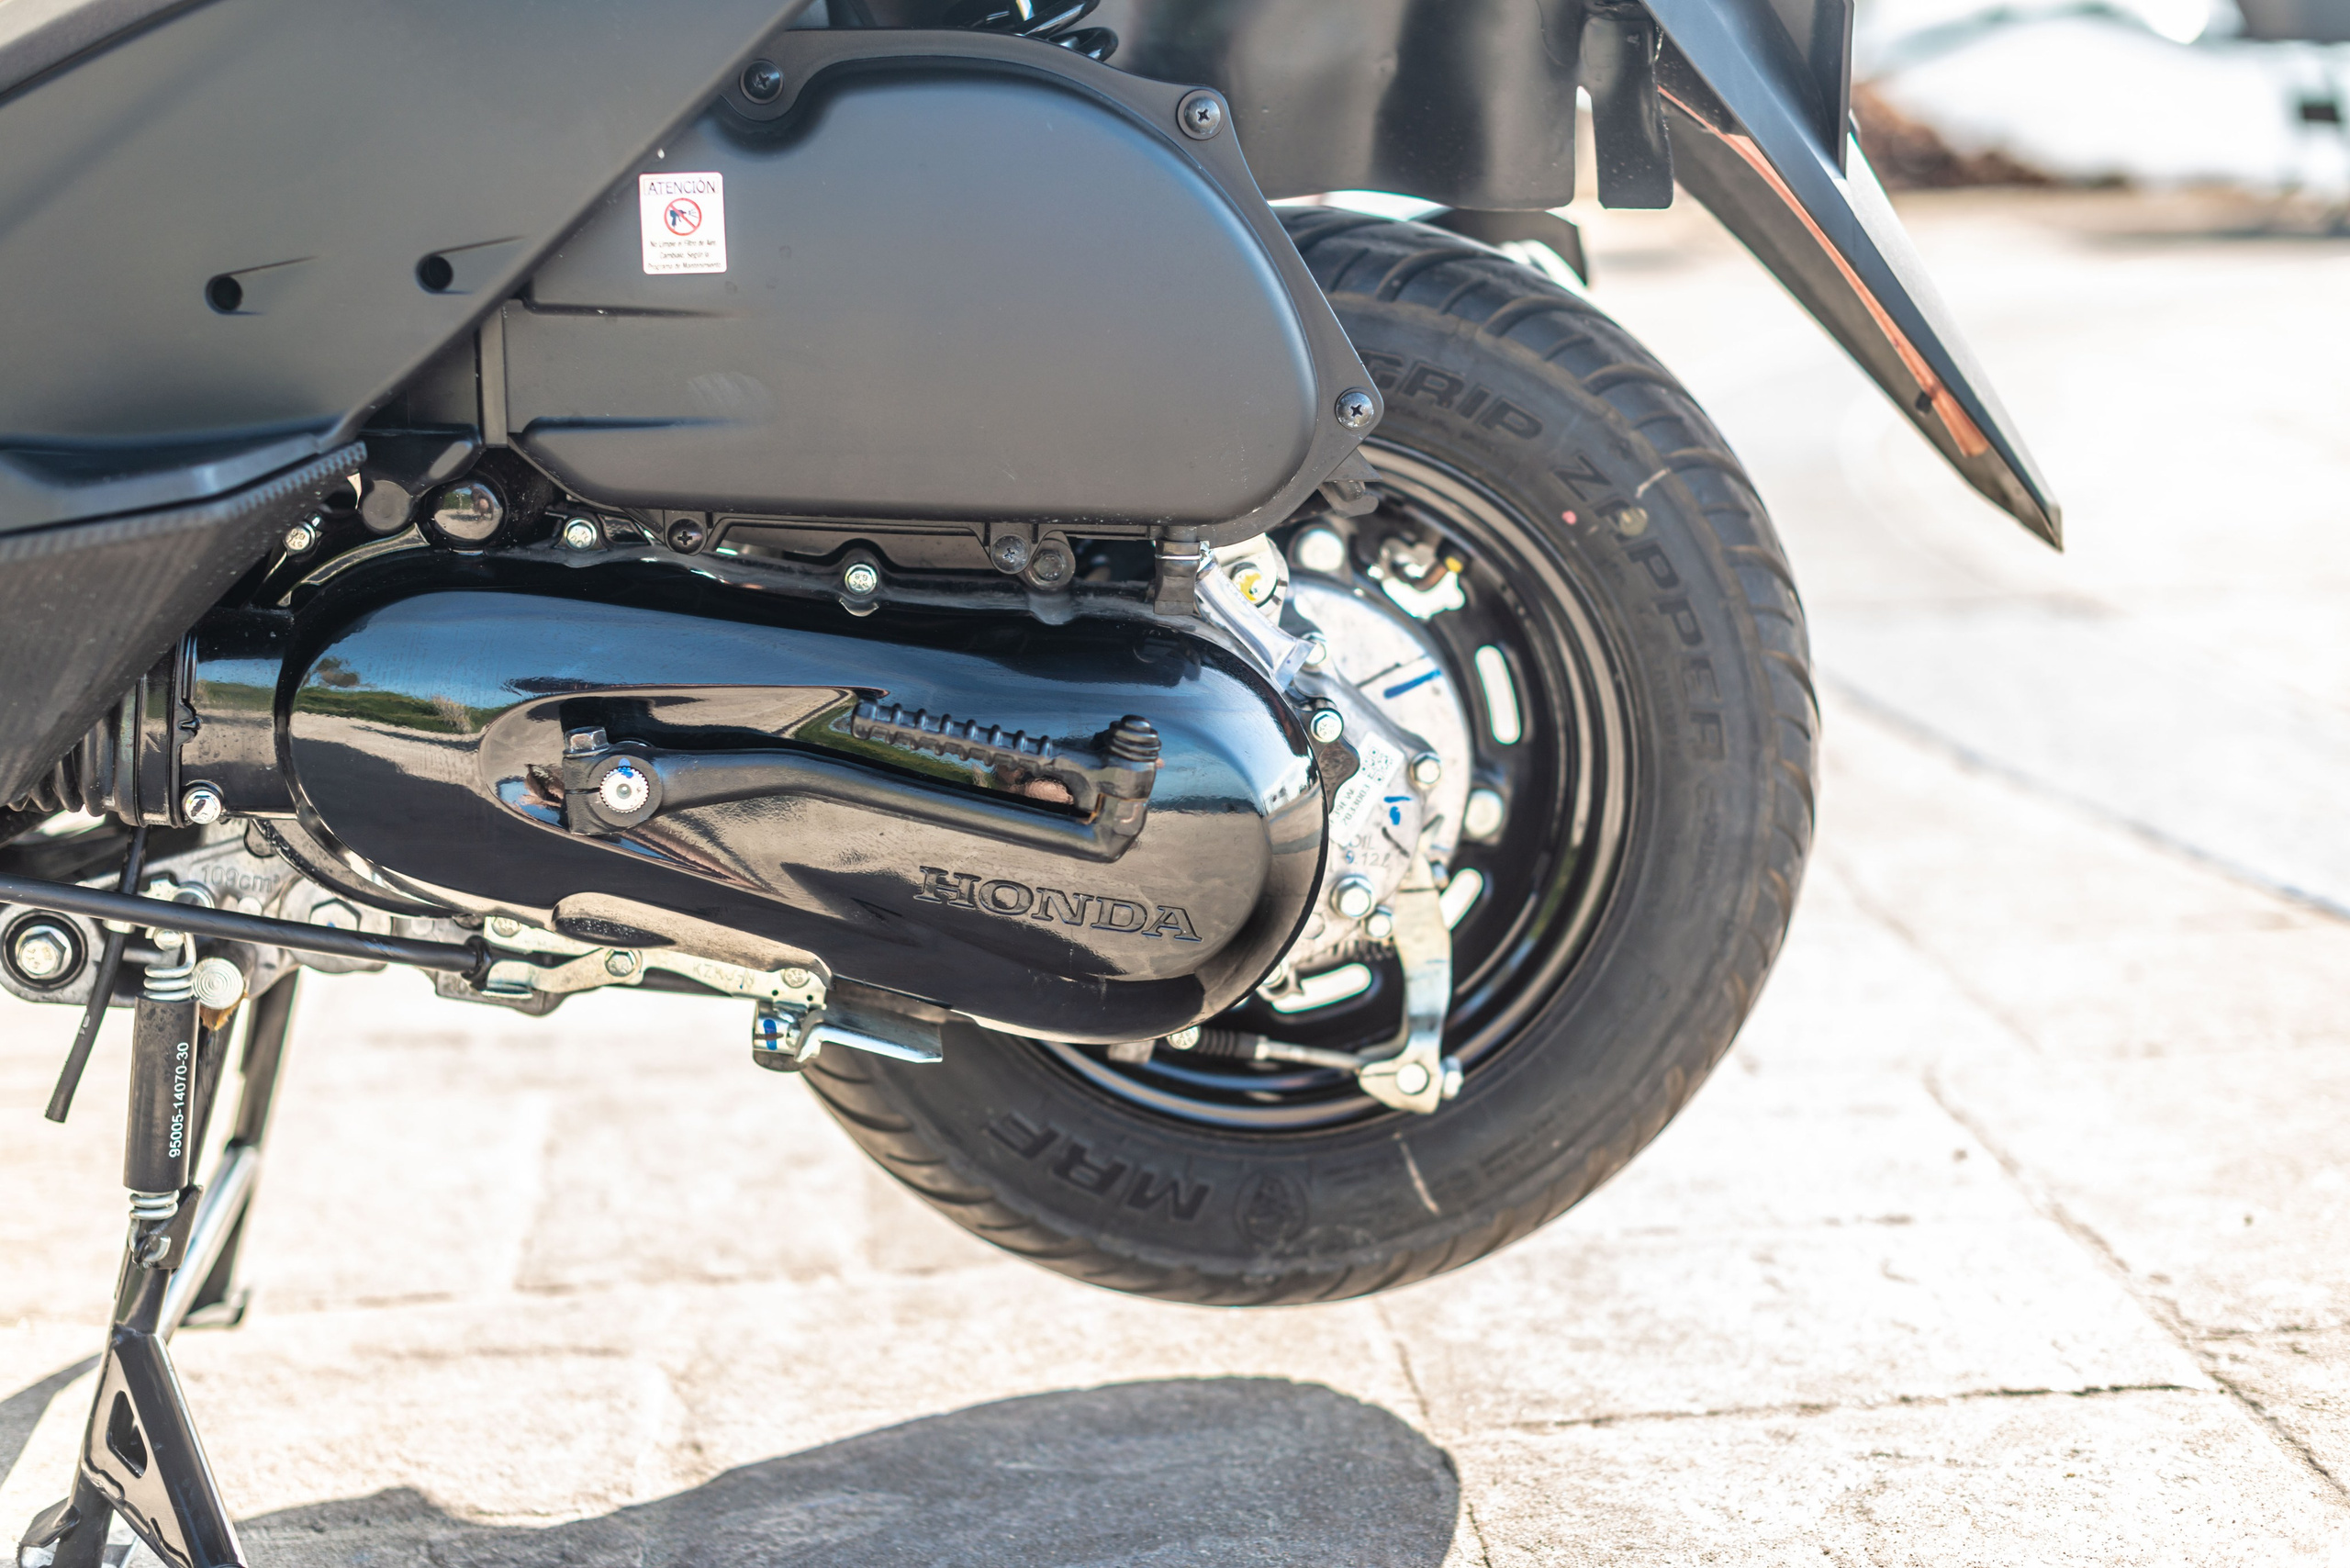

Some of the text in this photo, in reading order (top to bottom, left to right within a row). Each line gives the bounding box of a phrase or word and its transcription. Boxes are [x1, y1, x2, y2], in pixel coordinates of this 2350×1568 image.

[648, 178, 715, 195] ATENCIÓN
[1362, 349, 1543, 441] GRIP
[913, 866, 1203, 943] HONDA
[169, 1042, 189, 1159] 95005-14070-30
[987, 1111, 1212, 1221] MRF
